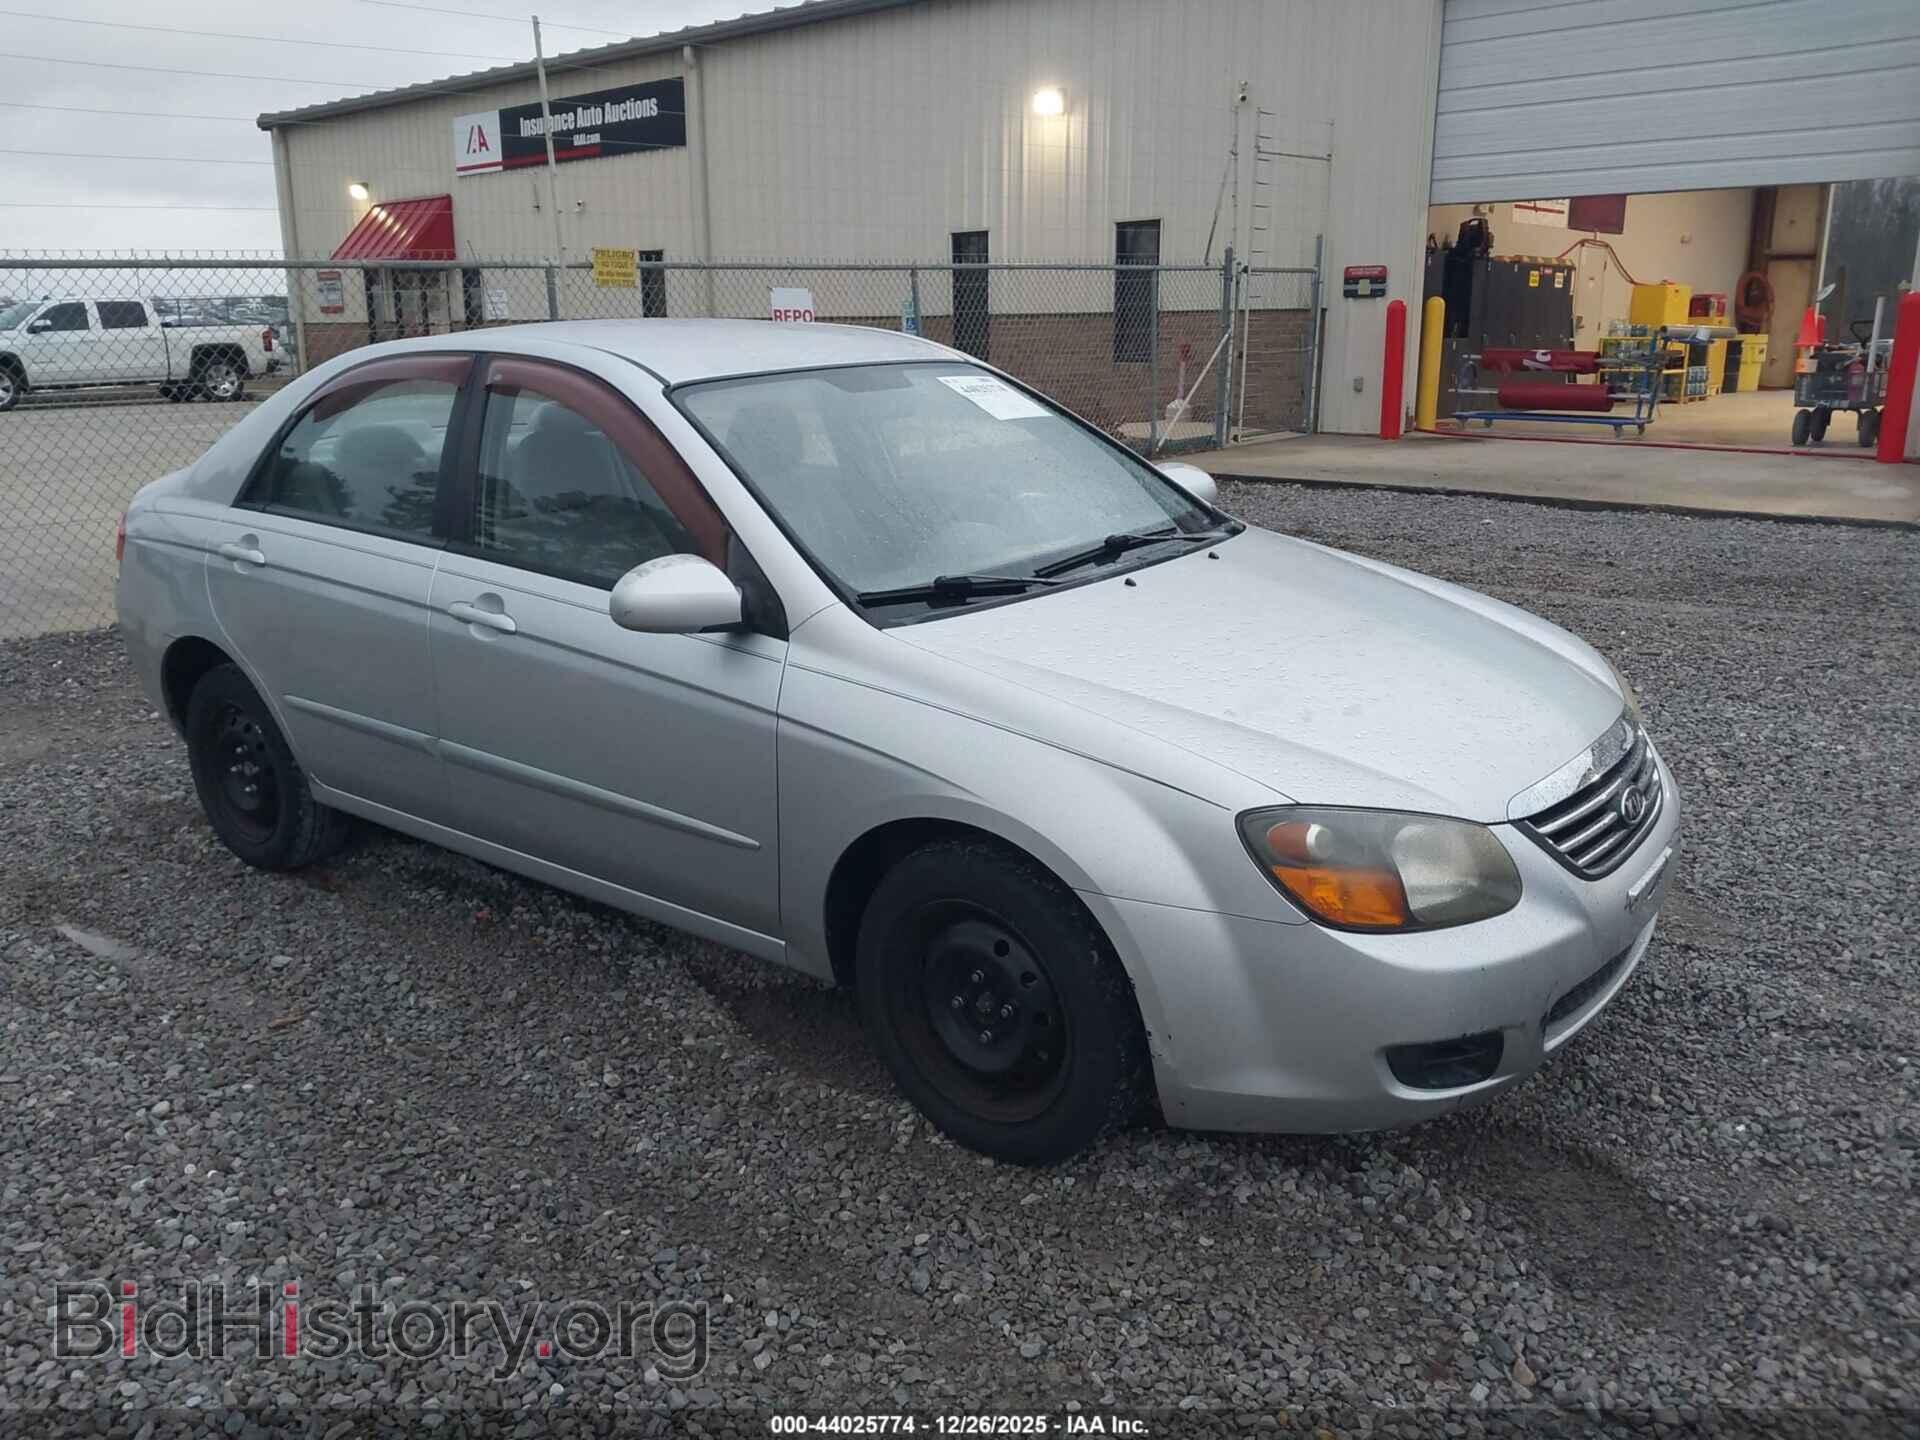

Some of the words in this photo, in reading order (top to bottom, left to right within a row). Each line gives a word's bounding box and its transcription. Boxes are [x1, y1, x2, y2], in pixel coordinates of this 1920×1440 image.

[520, 111, 575, 137] Insuance
[576, 106, 602, 129] Auto
[604, 97, 658, 124] Auctions
[773, 309, 813, 322] REPO
